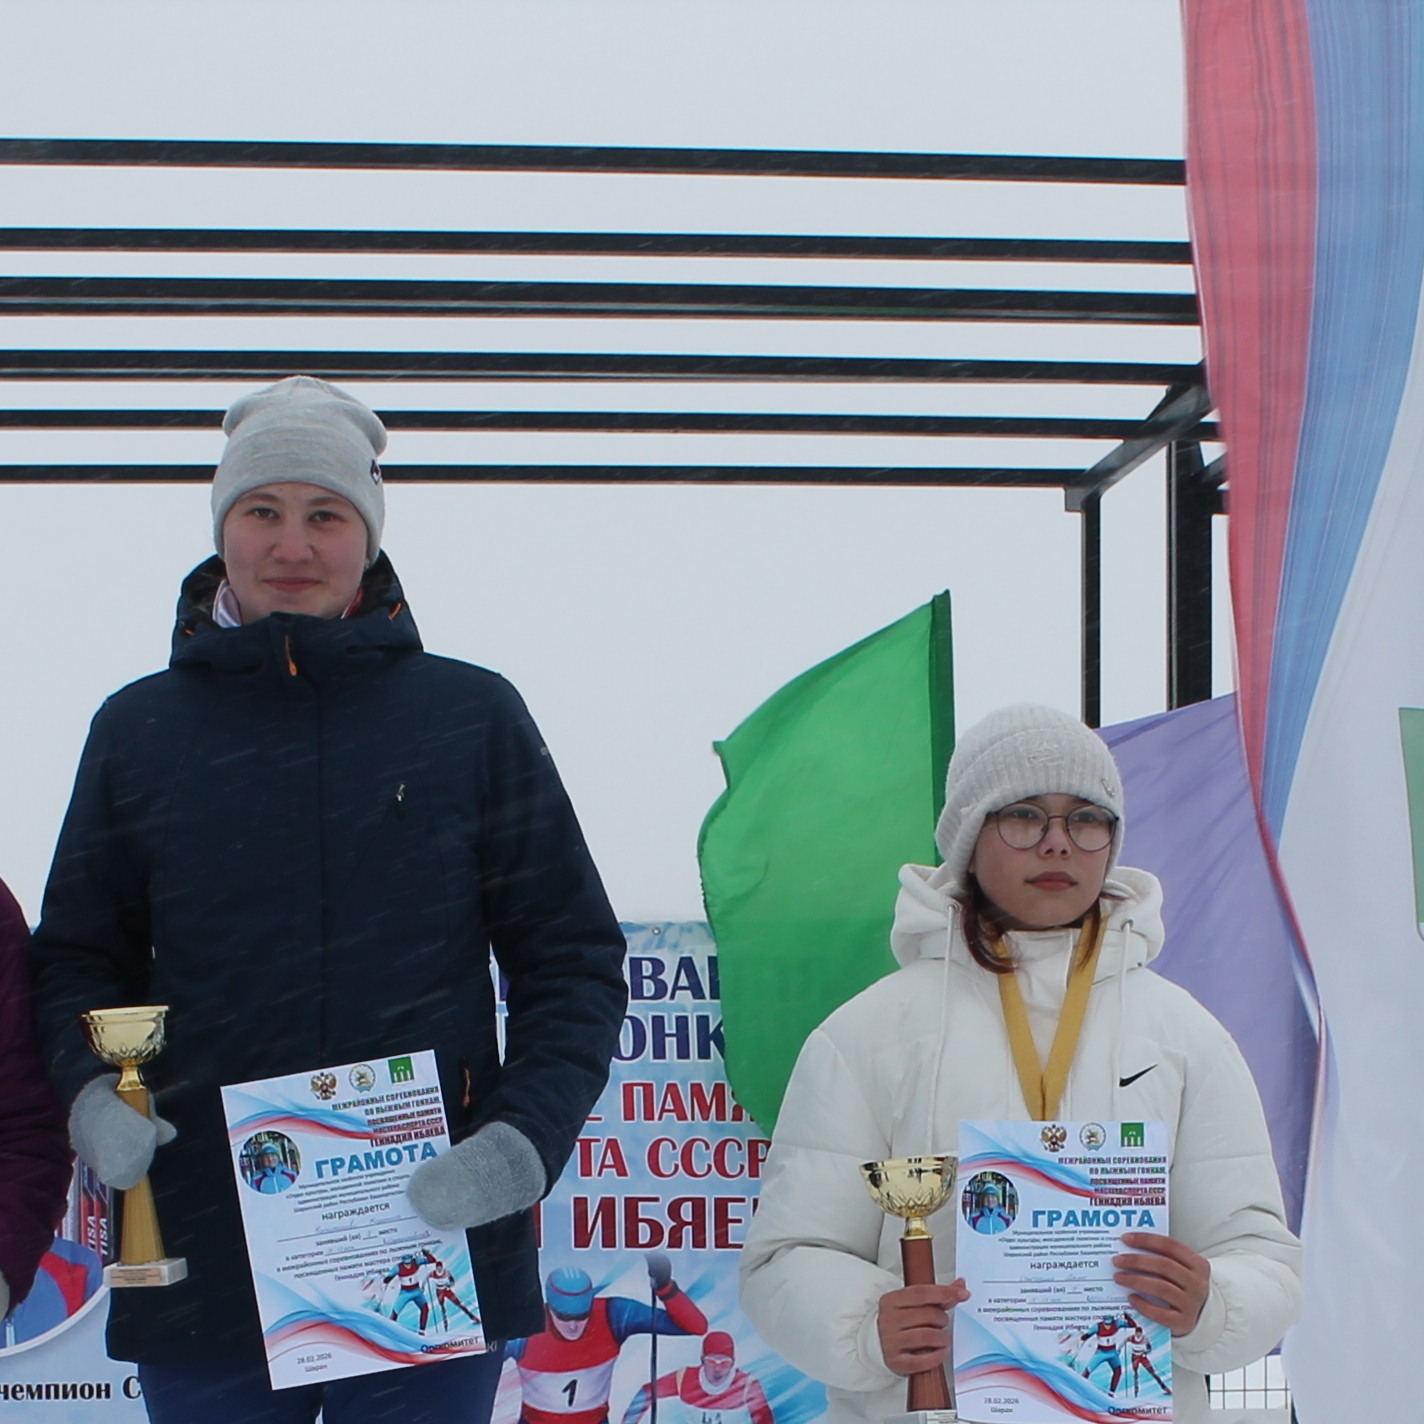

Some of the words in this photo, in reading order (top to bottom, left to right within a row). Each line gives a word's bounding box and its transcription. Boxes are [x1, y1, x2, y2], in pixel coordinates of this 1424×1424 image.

[315, 1141, 438, 1179] ГРАМОТА
[576, 1138, 628, 1177] ТА
[647, 1137, 770, 1178] СССР
[321, 1202, 391, 1222] награждается
[1033, 1209, 1154, 1227] ГРАМОТА
[573, 1196, 760, 1249] ИБЯЕ
[1031, 1262, 1100, 1270] награждается
[420, 1334, 480, 1354] Оргкомитет
[561, 1378, 578, 1408] 1
[1107, 1404, 1166, 1416] Оргкомитет
